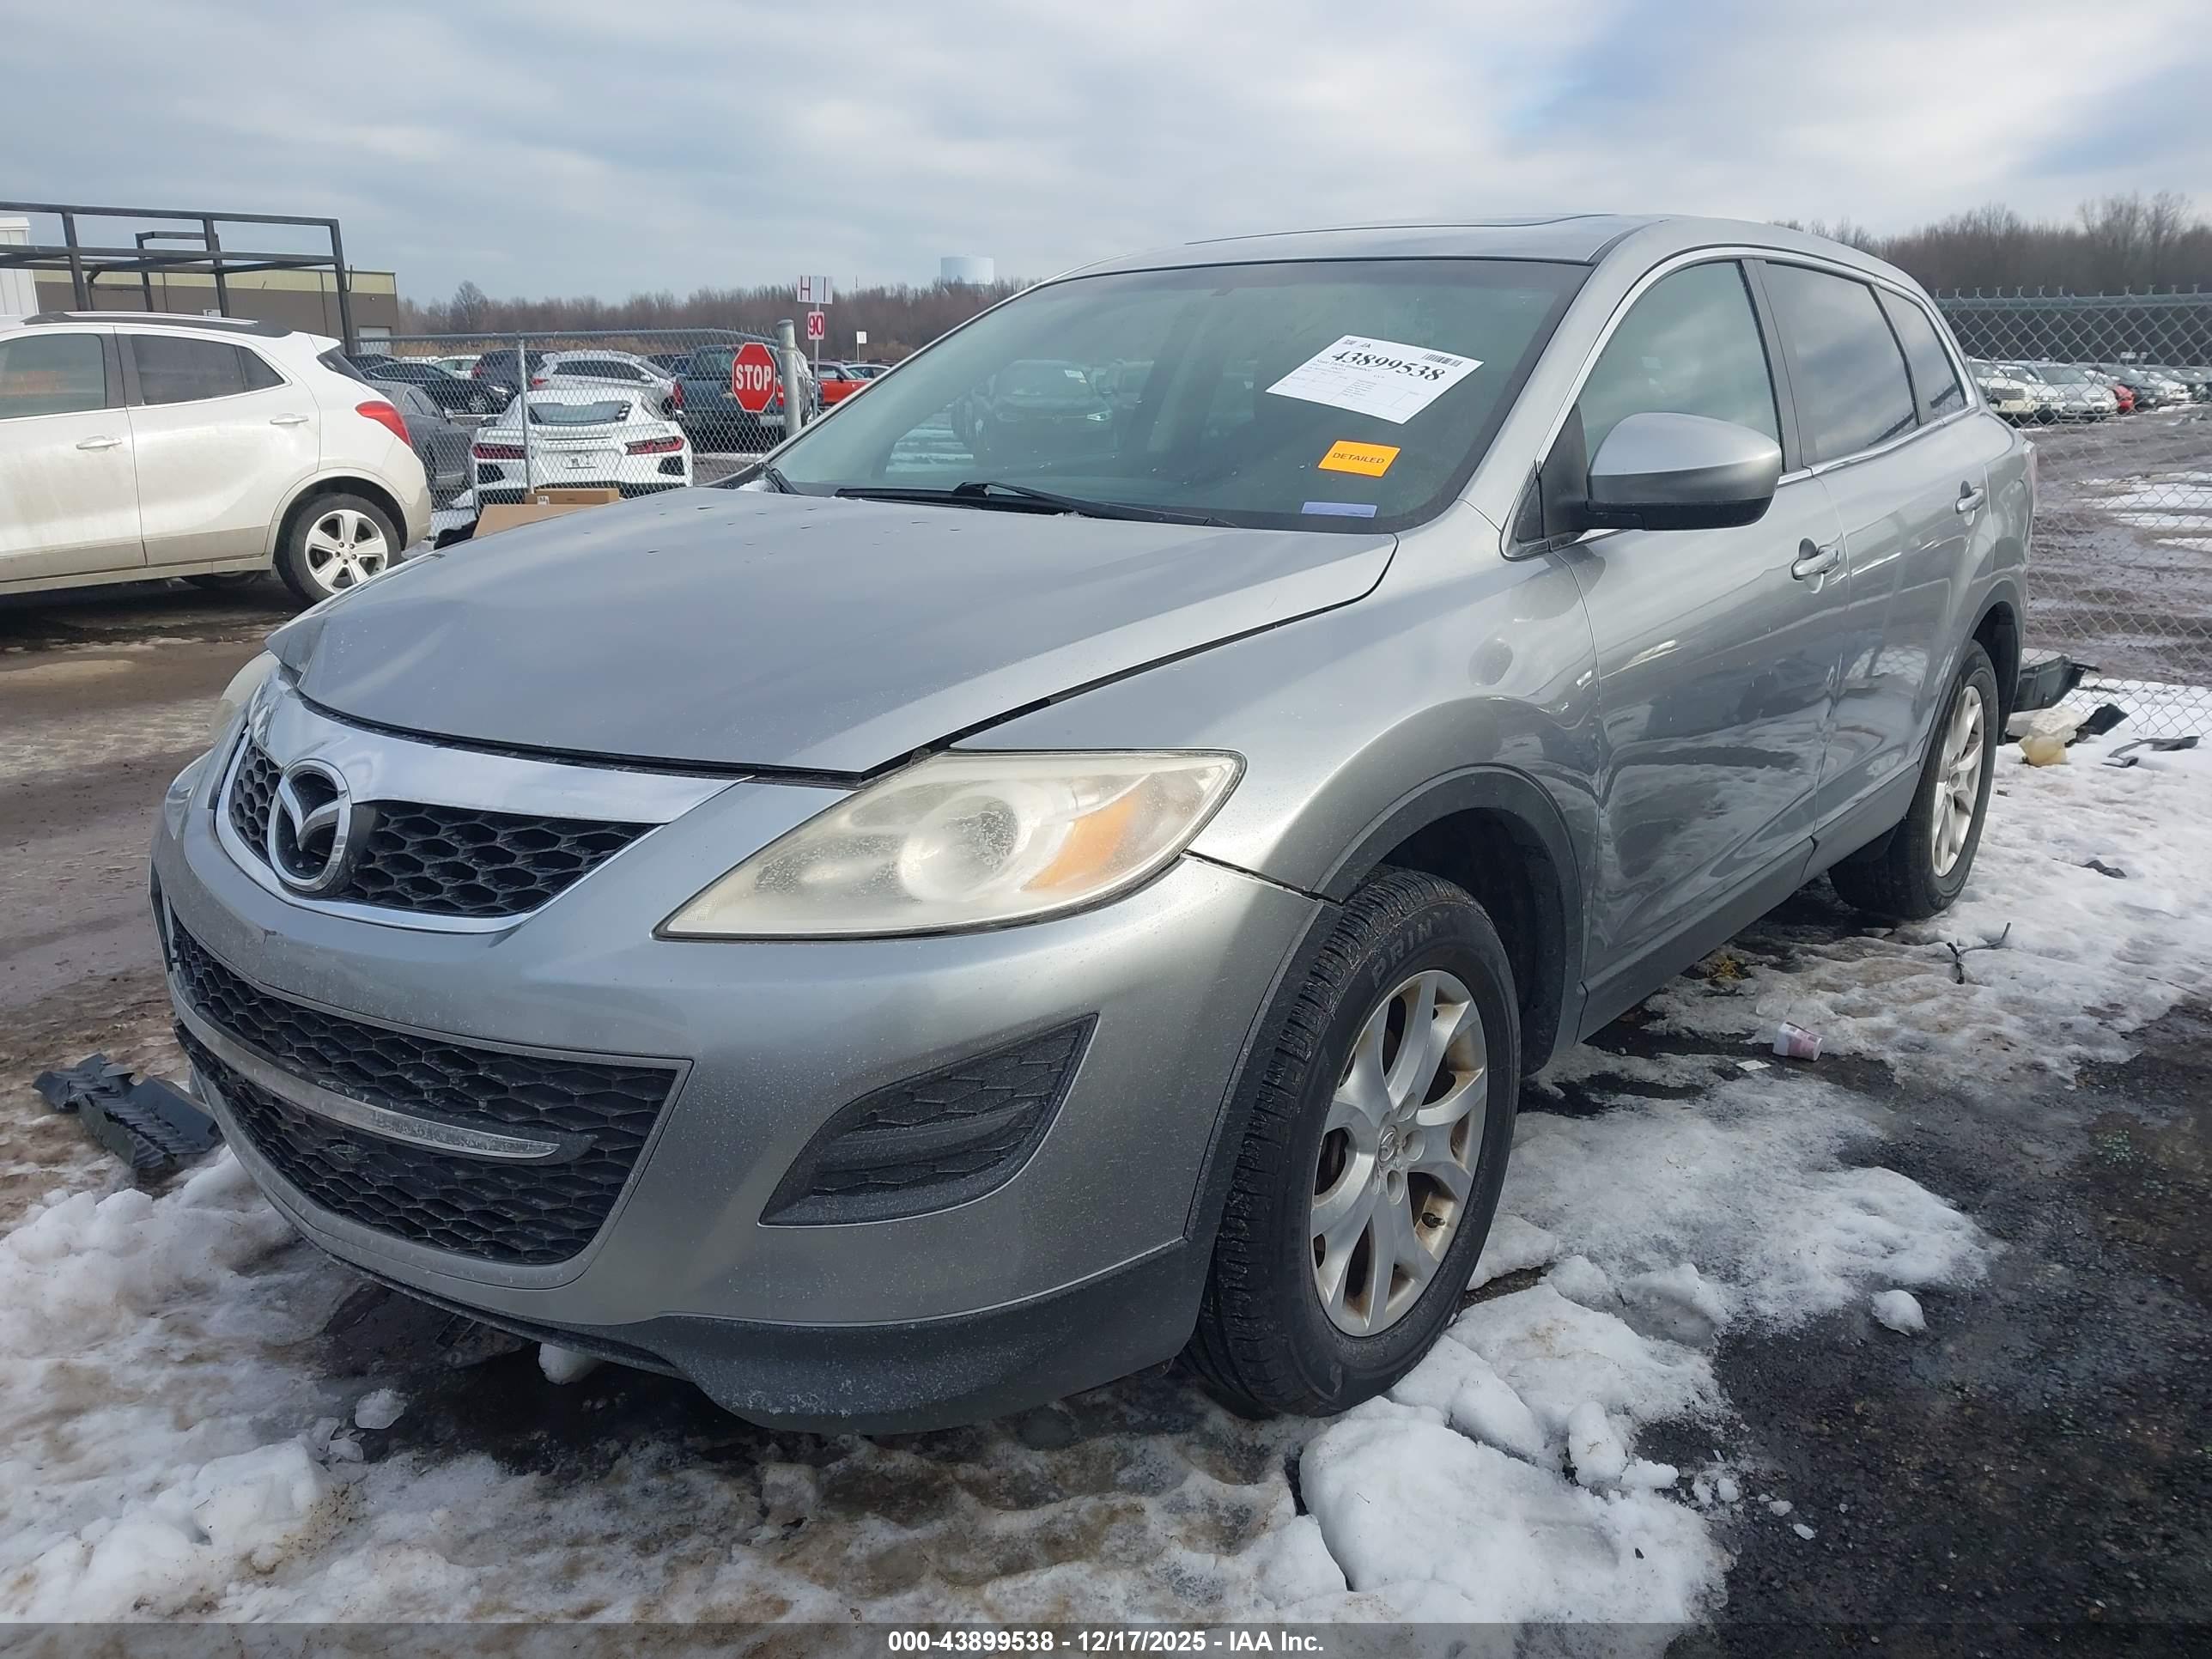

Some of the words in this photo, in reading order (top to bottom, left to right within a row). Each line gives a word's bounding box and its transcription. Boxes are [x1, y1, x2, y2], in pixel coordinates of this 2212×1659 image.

[799, 275, 811, 301] H
[808, 315, 824, 336] 90
[735, 364, 772, 392] STOP
[1330, 350, 1445, 381] 43899538
[1333, 452, 1385, 465] DETAILED
